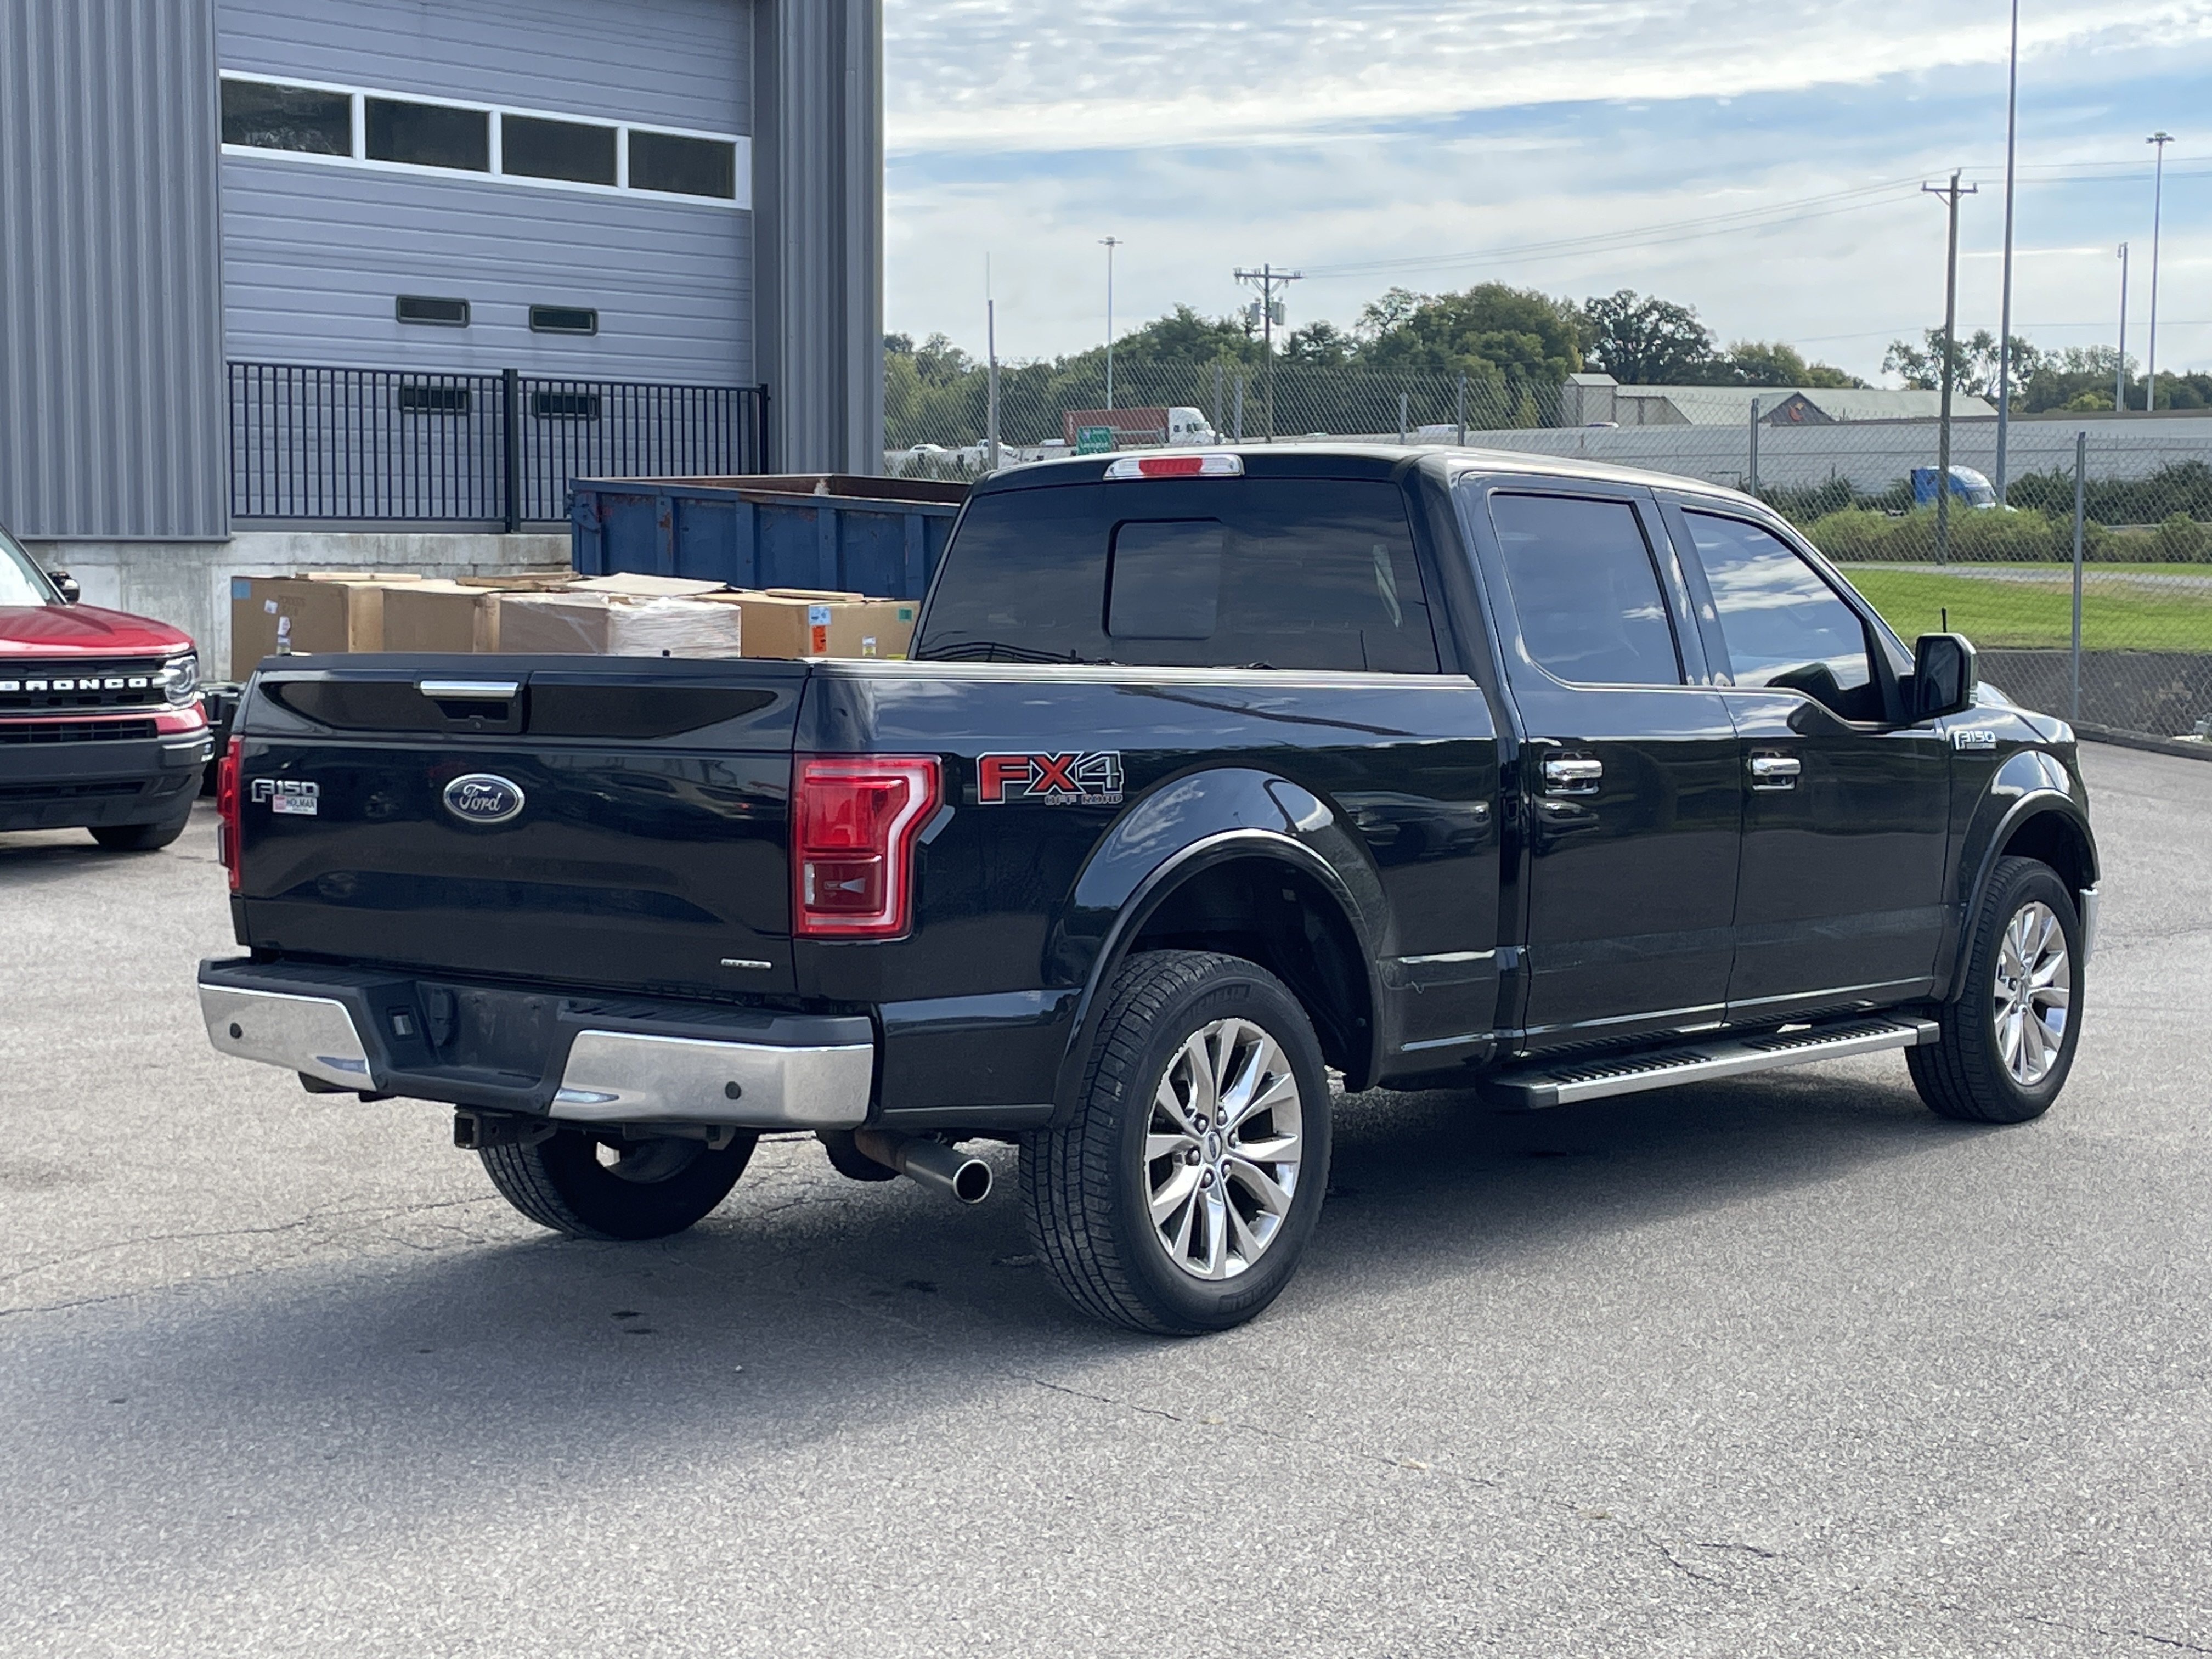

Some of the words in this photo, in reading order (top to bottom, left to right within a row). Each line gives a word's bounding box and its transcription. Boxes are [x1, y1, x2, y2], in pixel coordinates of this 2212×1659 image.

[976, 751, 1124, 804] FX4
[459, 783, 502, 811] Ford
[1045, 794, 1076, 806] OFF
[1081, 794, 1123, 805] ROAD
